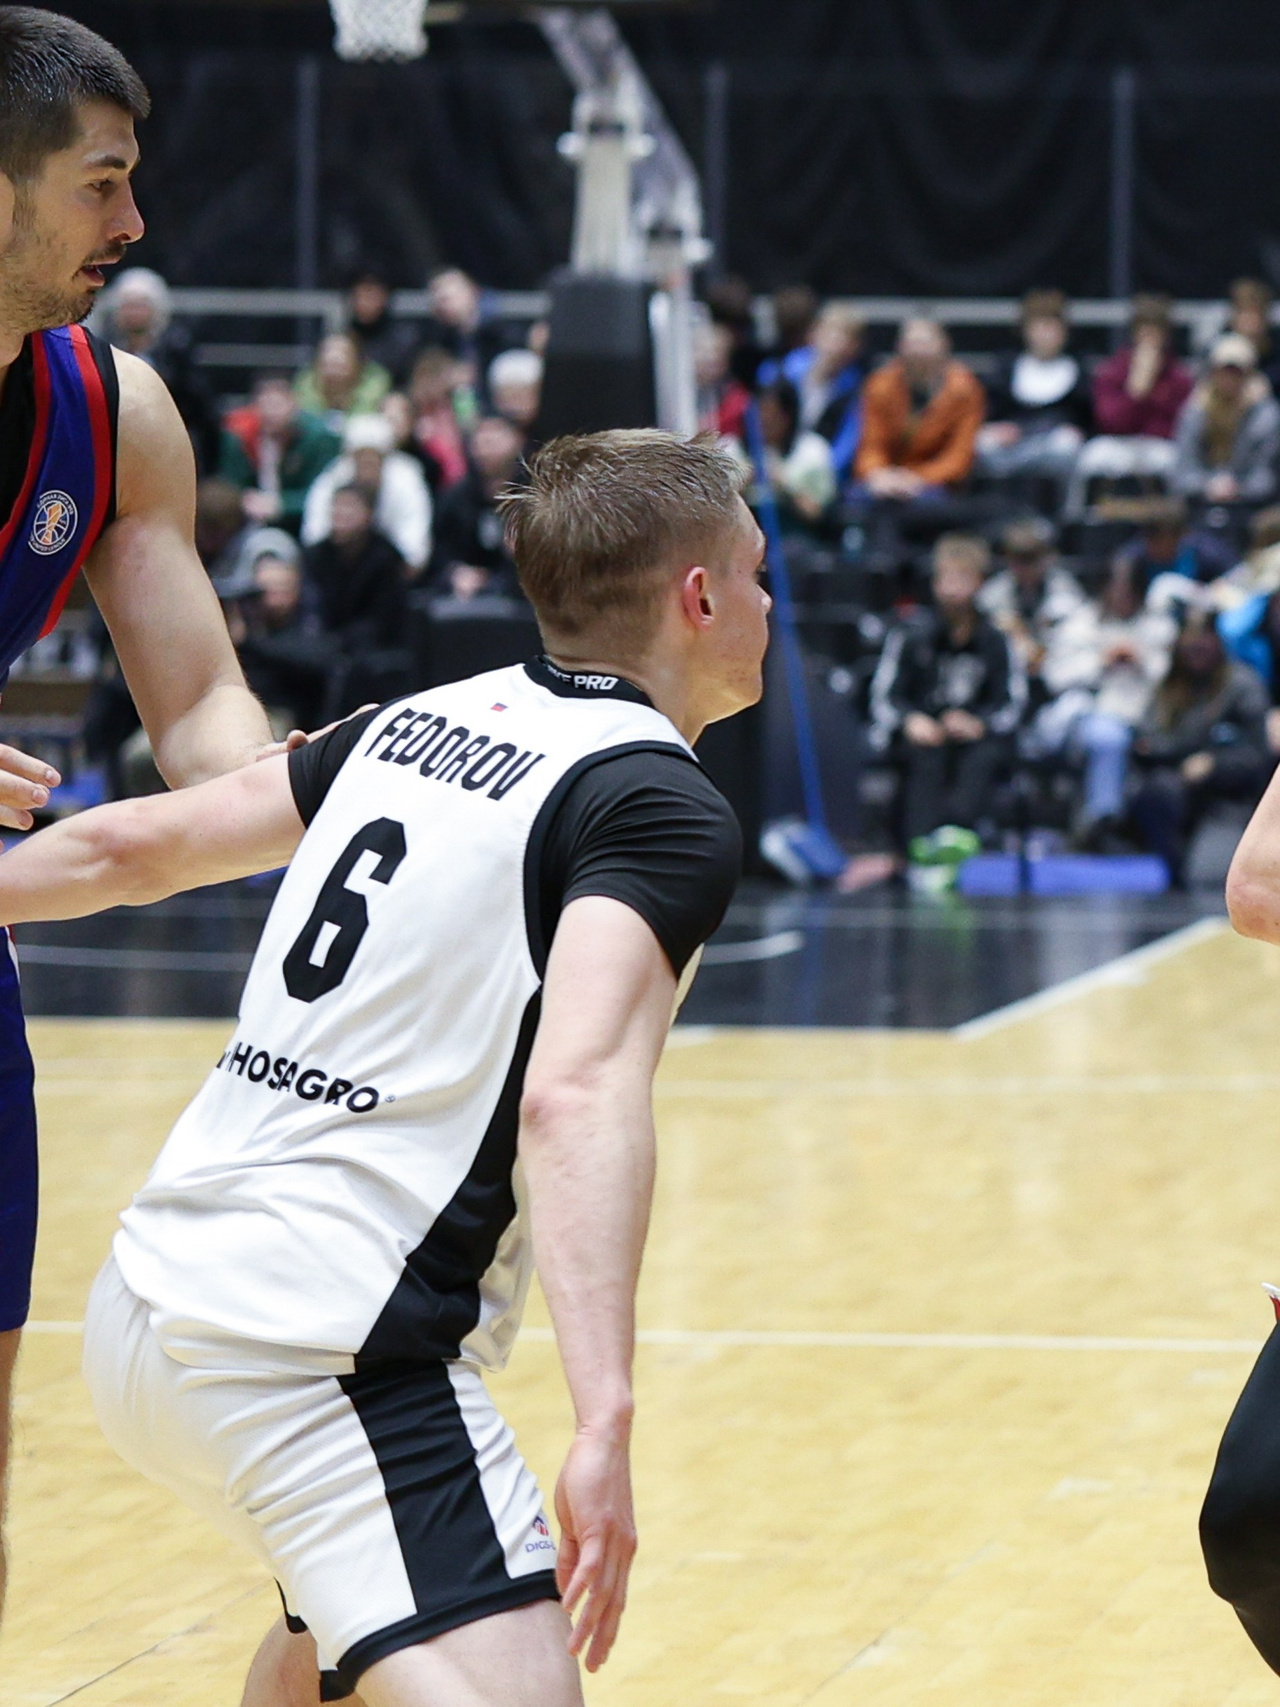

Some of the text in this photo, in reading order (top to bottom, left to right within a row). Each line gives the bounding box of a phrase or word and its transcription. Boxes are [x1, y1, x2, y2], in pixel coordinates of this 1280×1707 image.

[573, 675, 619, 690] PRO
[363, 707, 547, 802] FEDOROV
[282, 816, 407, 1004] 6
